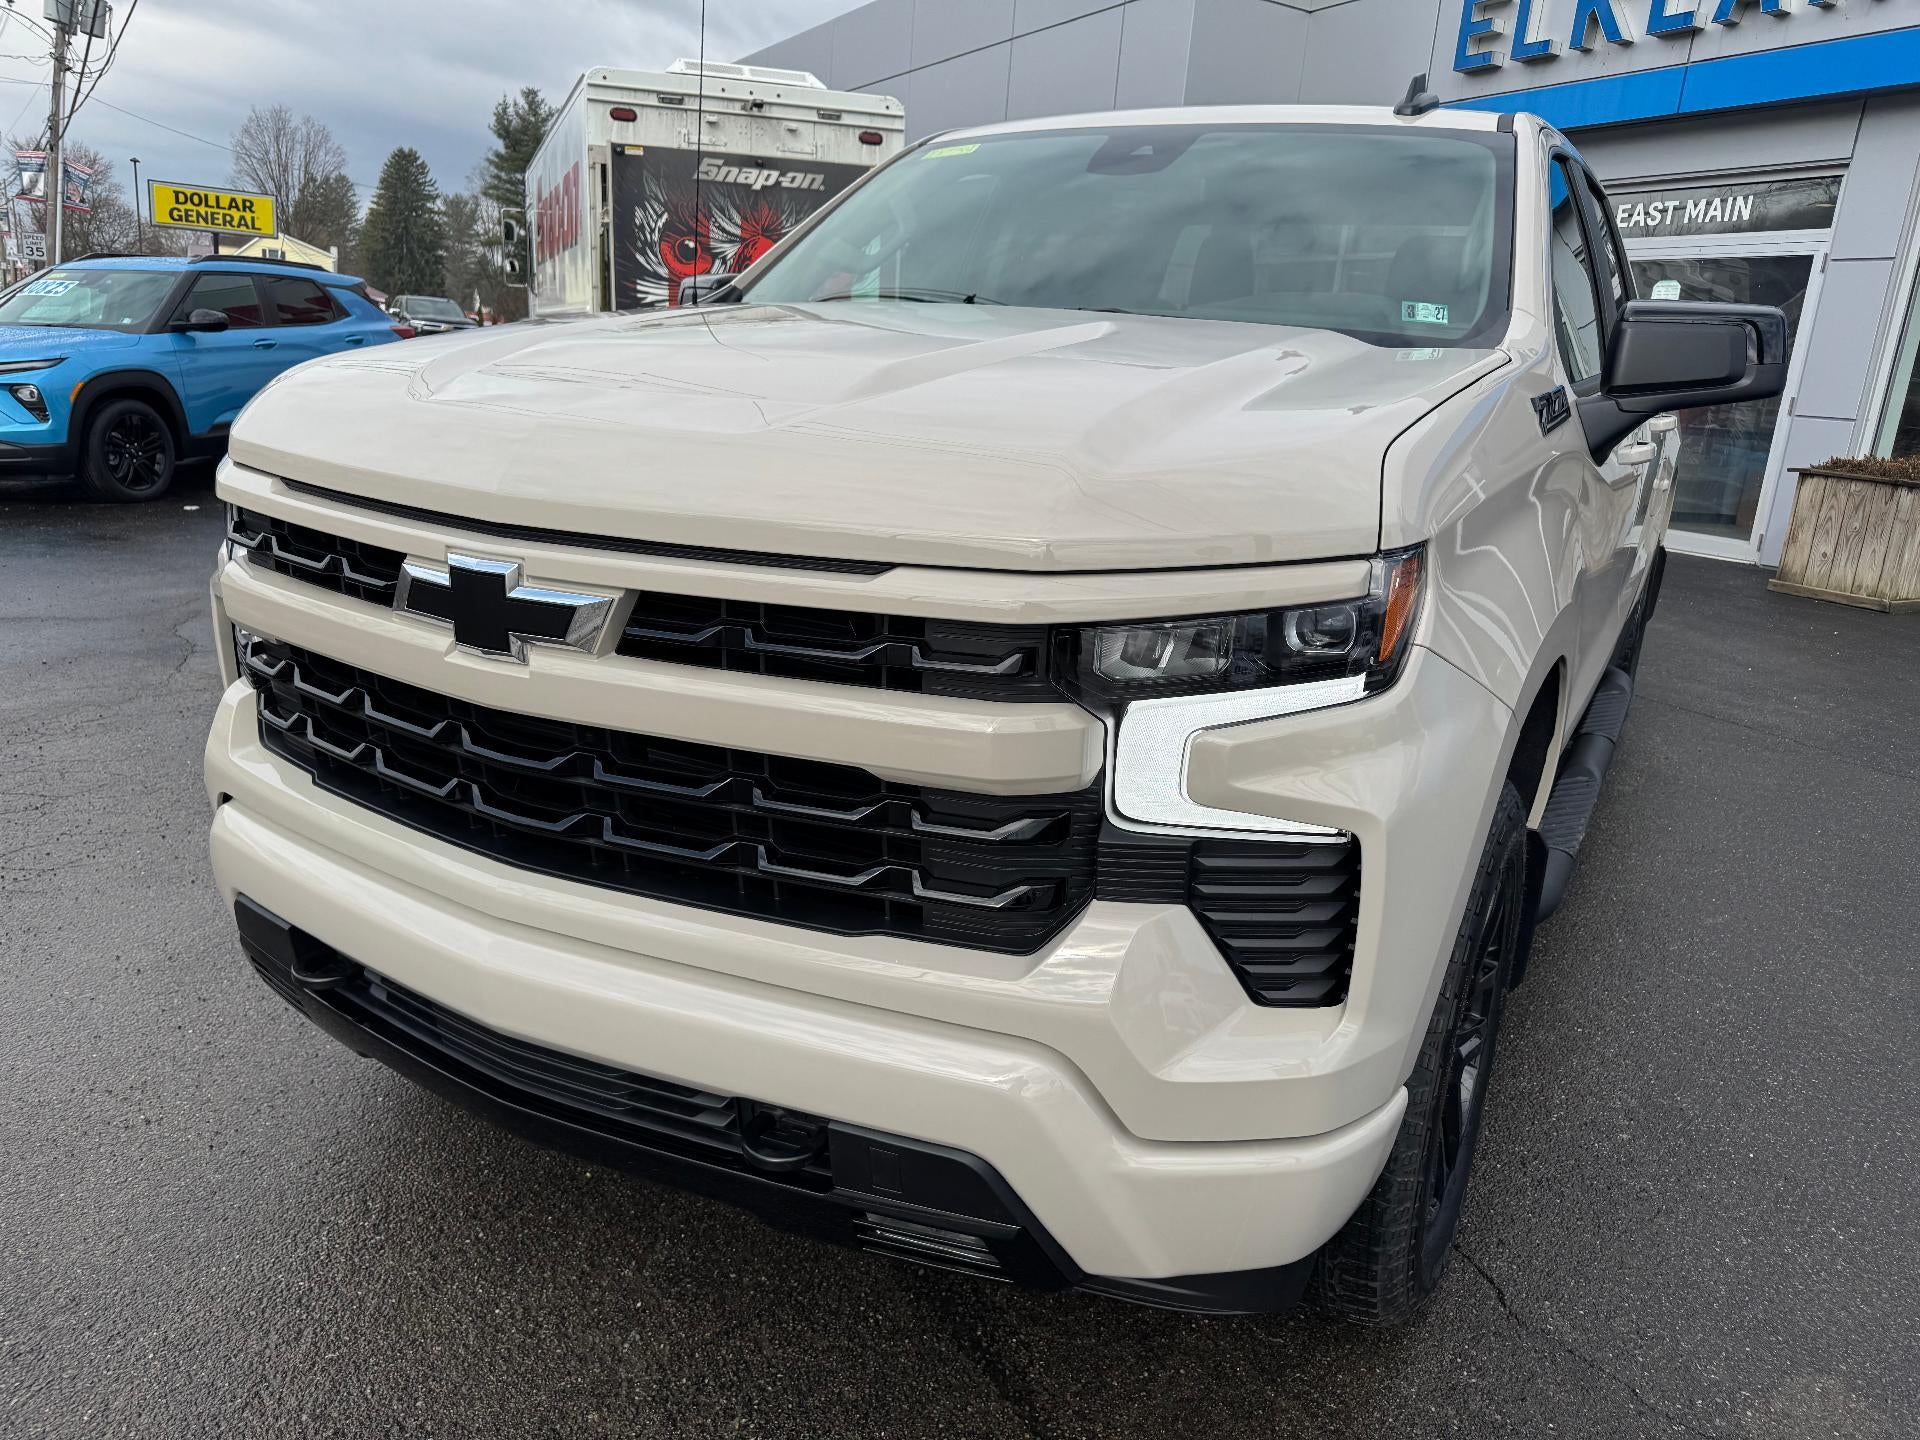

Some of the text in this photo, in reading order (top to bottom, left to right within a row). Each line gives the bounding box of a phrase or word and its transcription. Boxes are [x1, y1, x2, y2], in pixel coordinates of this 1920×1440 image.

[173, 190, 255, 213] DOLLAR
[1616, 195, 1753, 228] EAST MAIN
[169, 207, 262, 230] GENERAL
[25, 246, 45, 257] 35
[1435, 306, 1446, 321] 27
